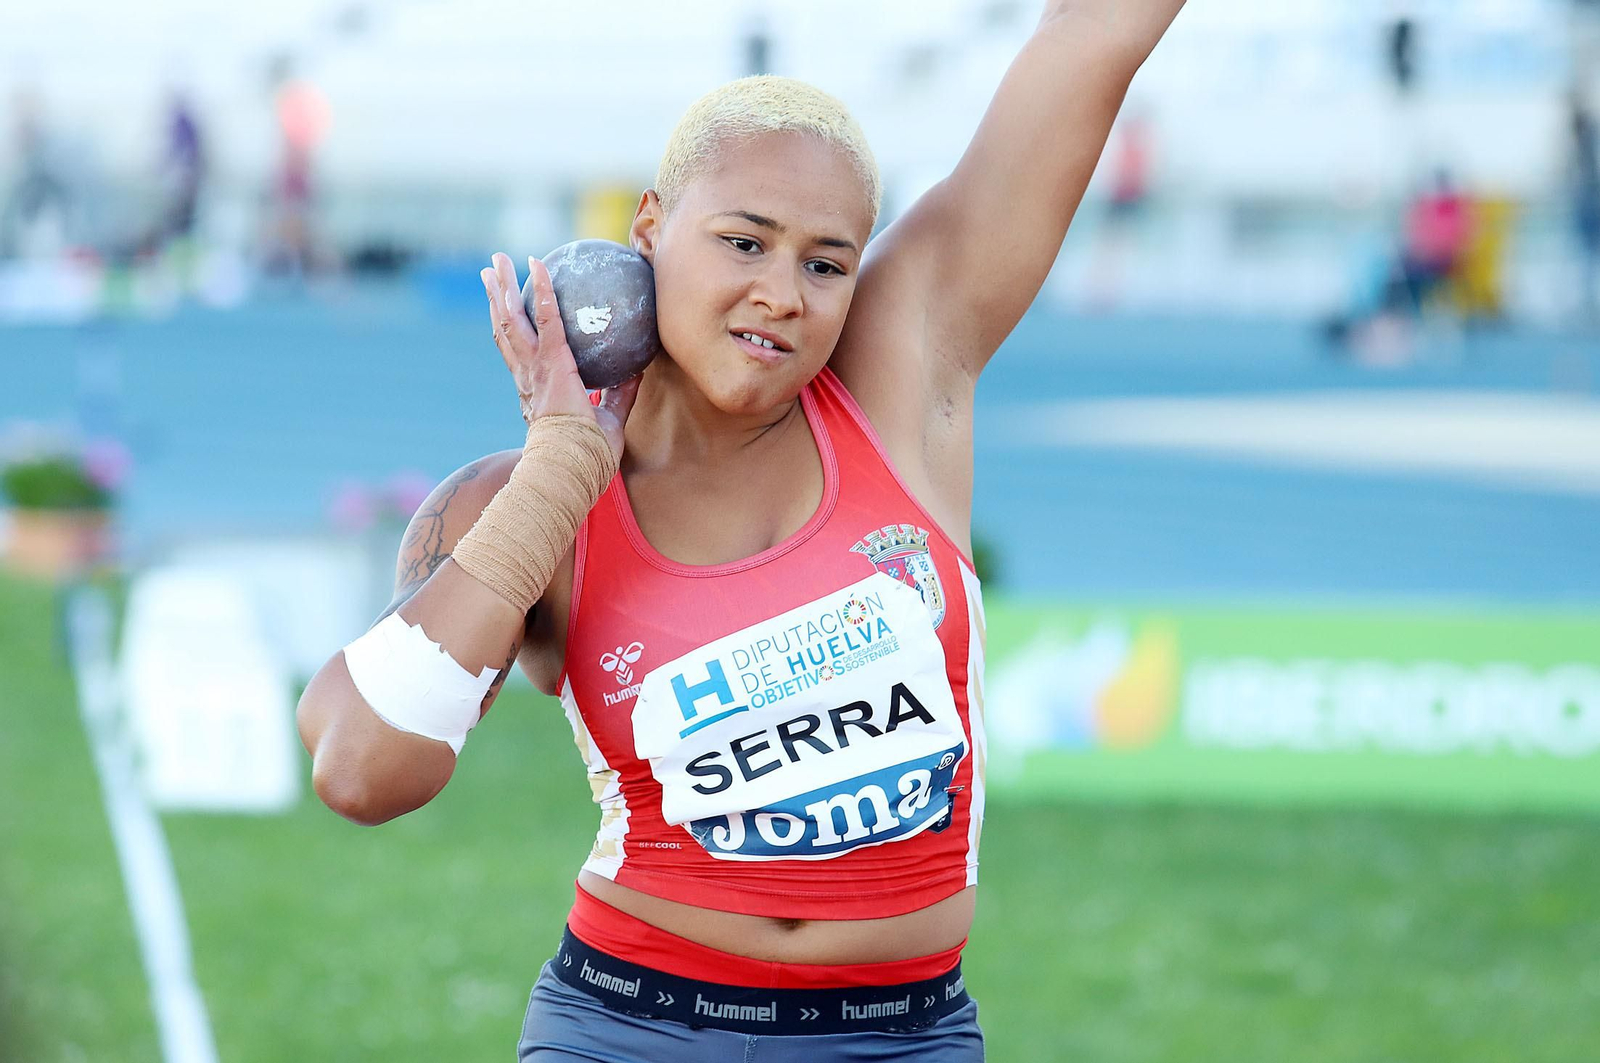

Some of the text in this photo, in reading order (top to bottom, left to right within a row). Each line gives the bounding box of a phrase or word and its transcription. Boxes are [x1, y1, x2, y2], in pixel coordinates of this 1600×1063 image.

[732, 592, 884, 671] DIPUTACIÓN
[842, 635, 897, 664] DE DESARROLLO
[741, 617, 893, 694] DE HUELVA
[845, 641, 901, 672] SOSTENIBLE
[751, 660, 846, 709] OBJETIVOS
[685, 682, 936, 795] SERRA
[580, 959, 641, 998] hummel
[695, 993, 777, 1022] hummel
[842, 994, 910, 1020] hummel
